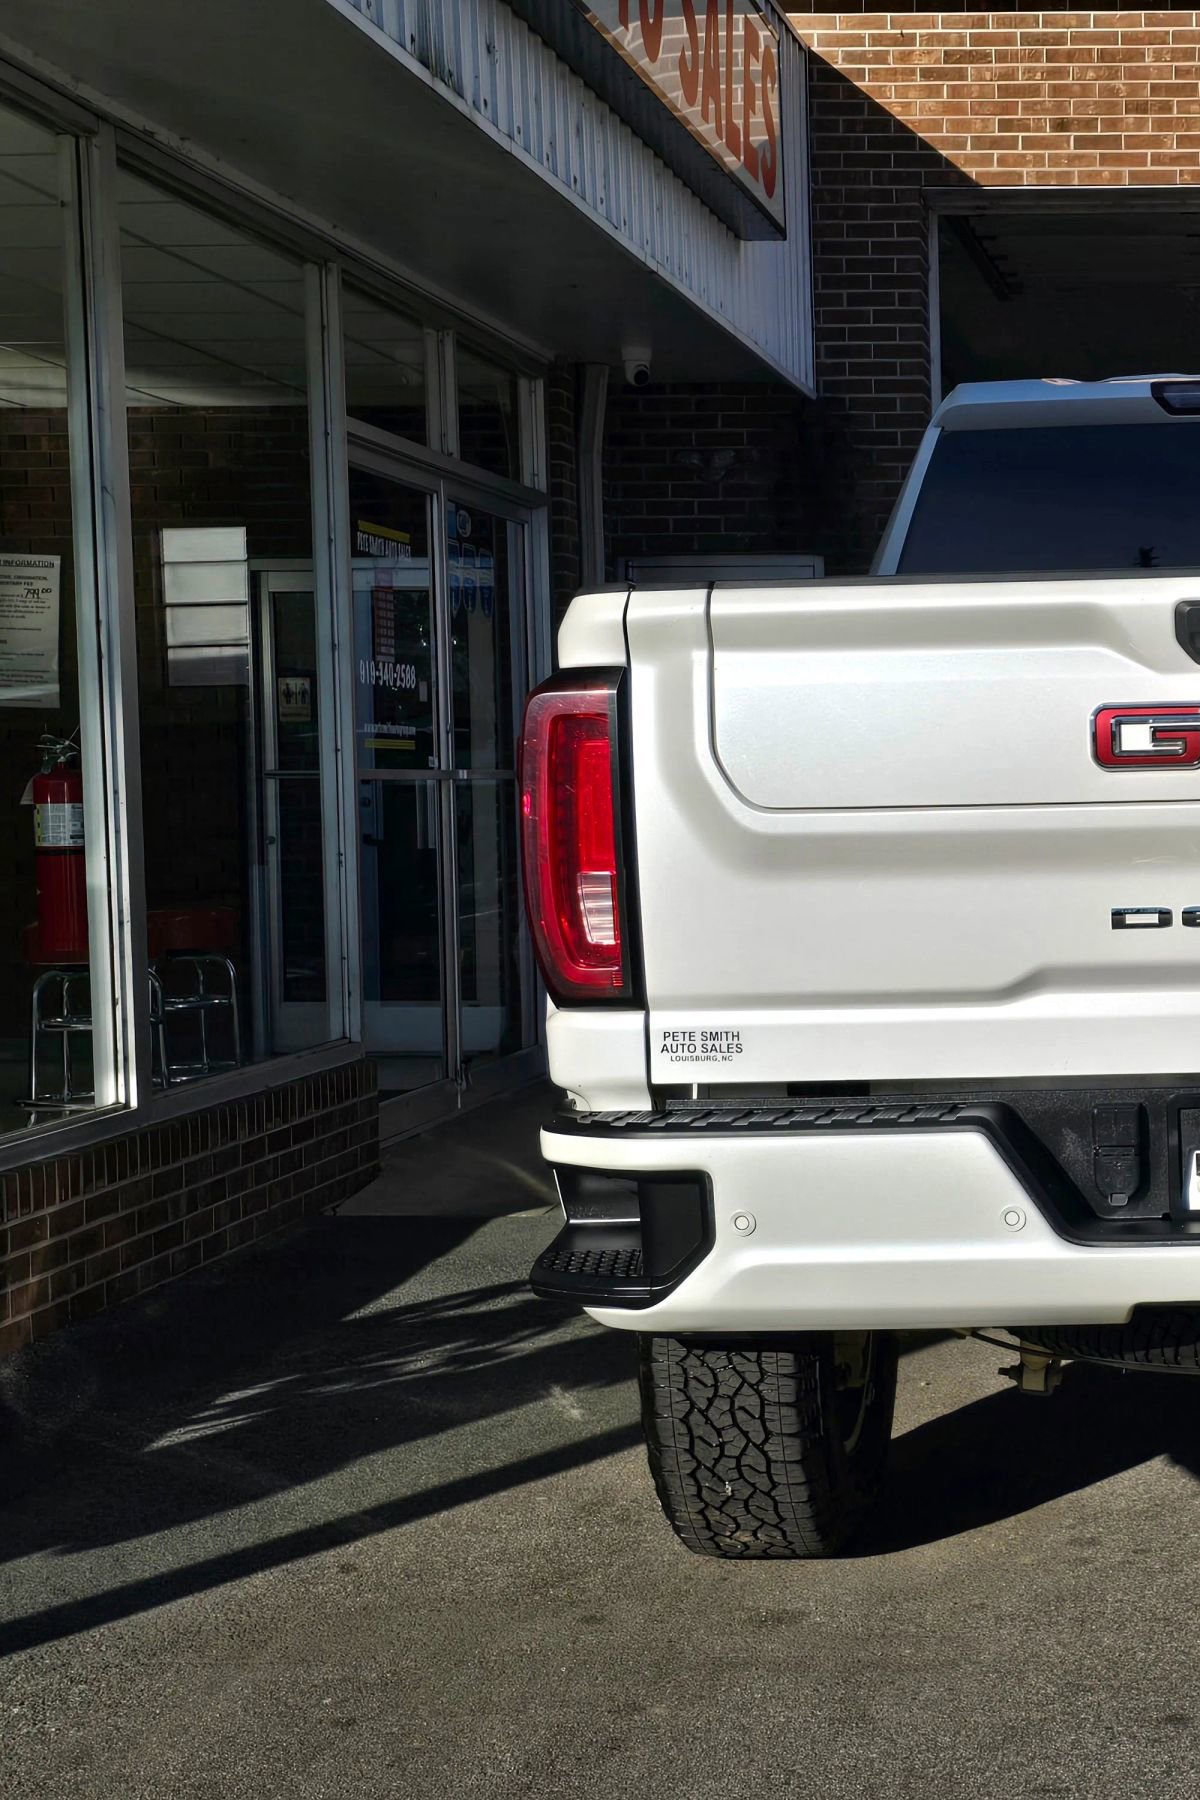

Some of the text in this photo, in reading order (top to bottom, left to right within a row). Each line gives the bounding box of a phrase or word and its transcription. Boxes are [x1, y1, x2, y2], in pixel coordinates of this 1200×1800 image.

[678, 0, 777, 199] SALES
[3, 559, 55, 568] INFORMATION
[360, 658, 416, 689] 919-340-2588
[663, 1031, 740, 1042] PETE SMITH
[660, 1043, 743, 1054] AUTO SALES
